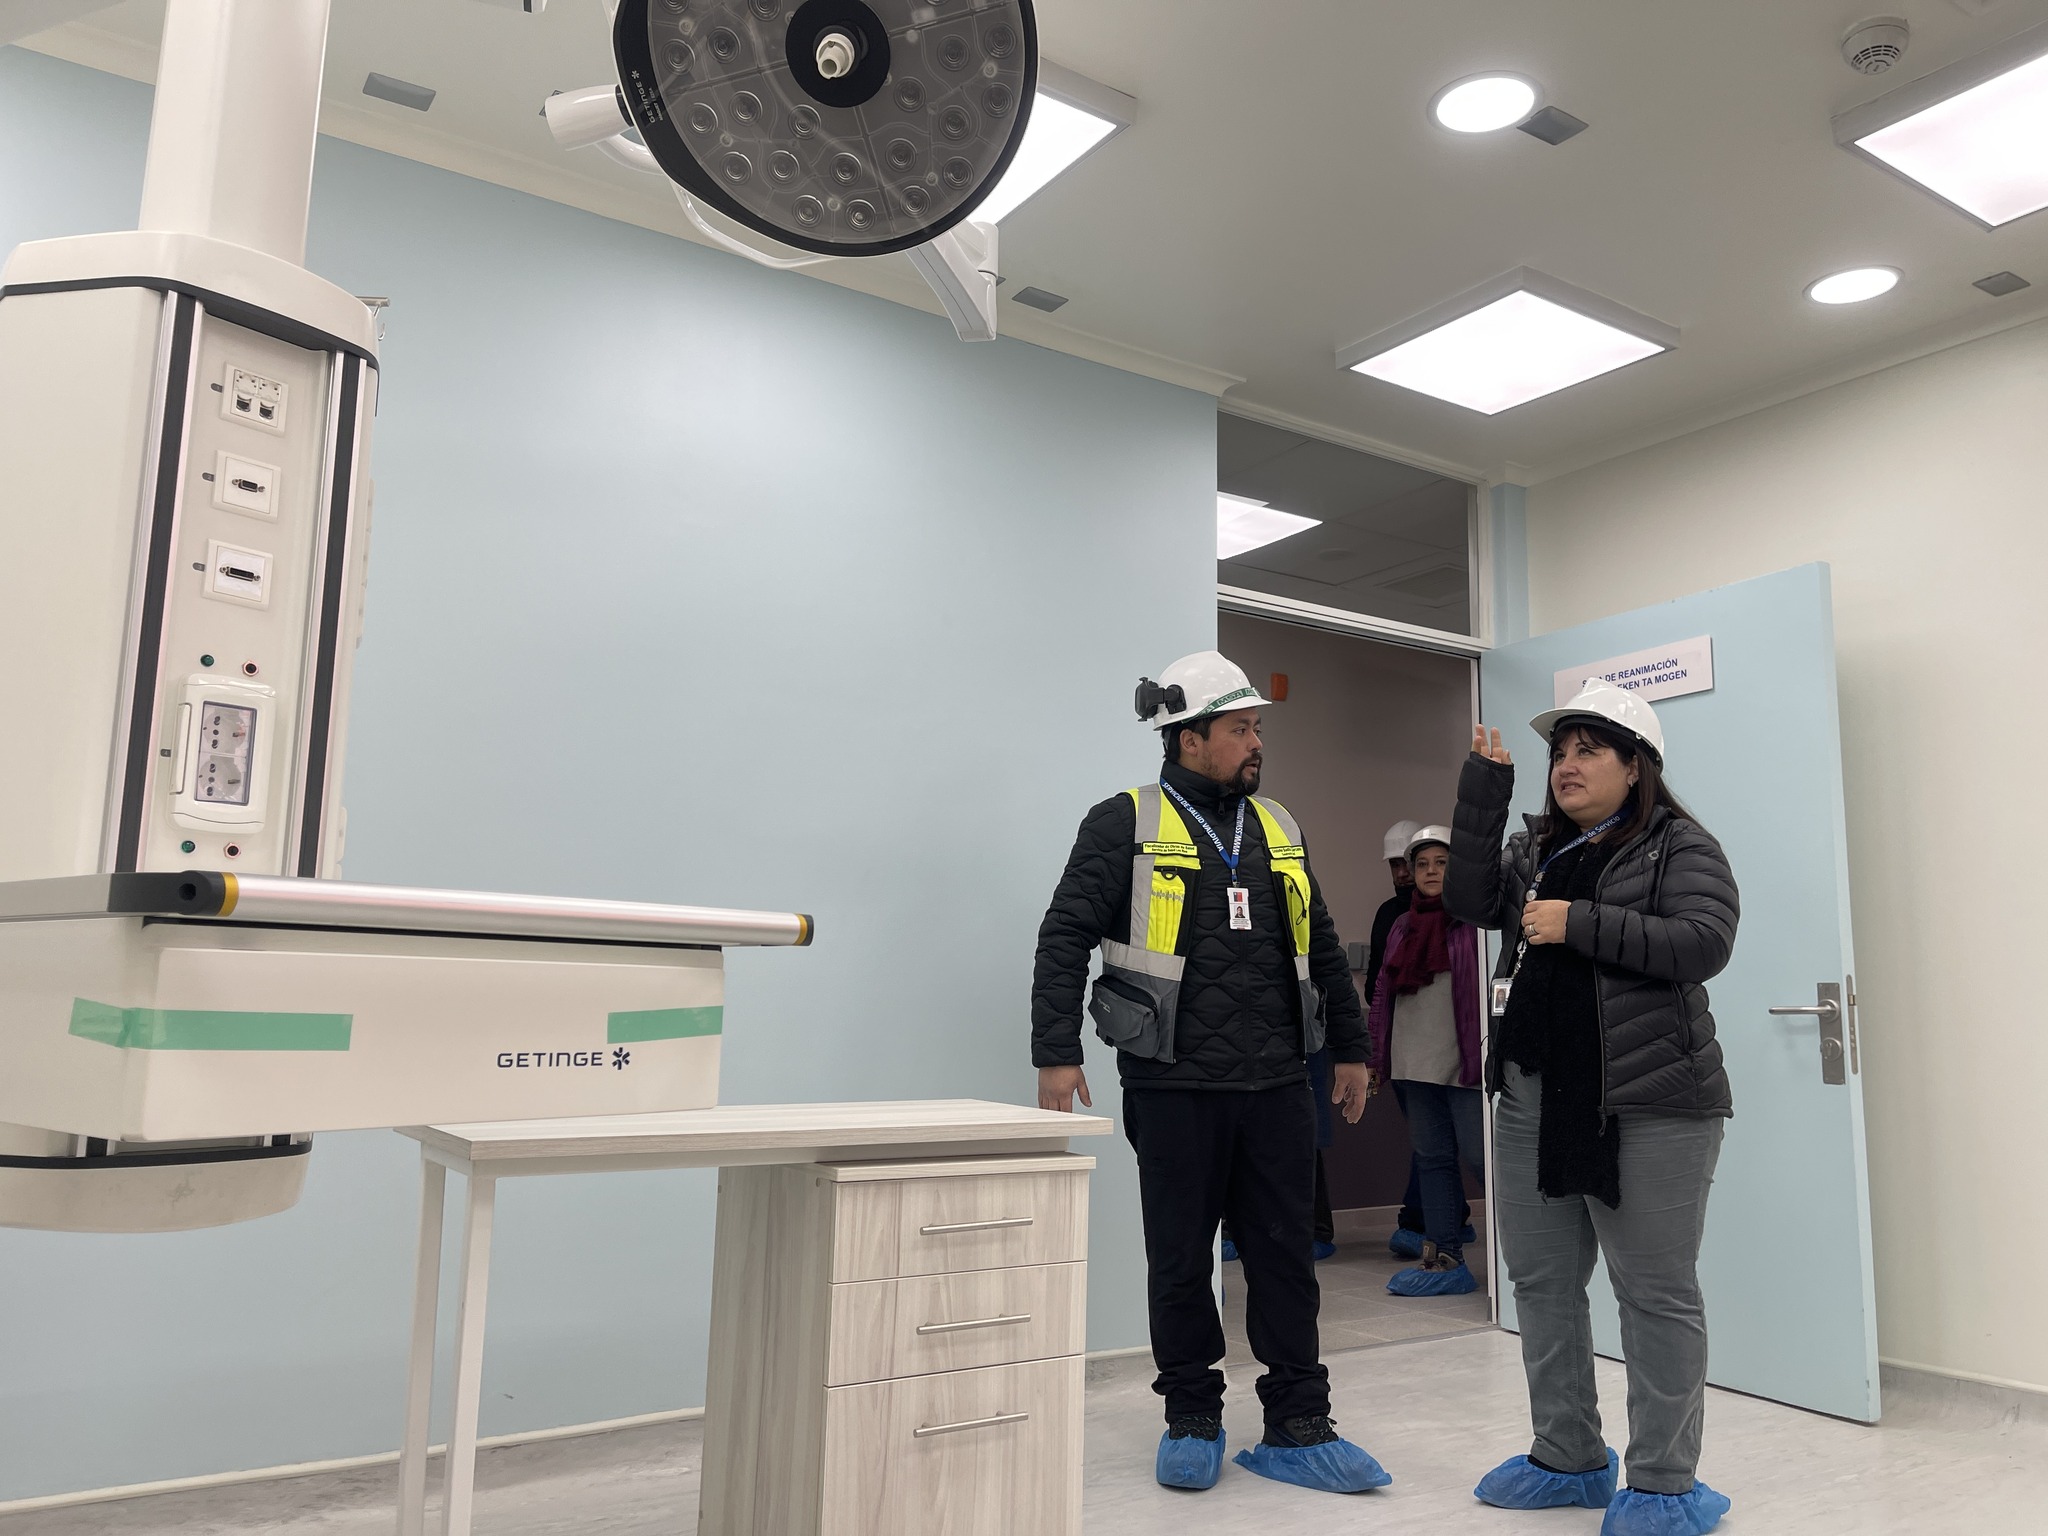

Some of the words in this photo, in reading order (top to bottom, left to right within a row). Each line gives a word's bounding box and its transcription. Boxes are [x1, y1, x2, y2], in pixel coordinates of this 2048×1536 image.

[636, 81, 655, 123] GETINGE
[1605, 672, 1616, 682] DE
[1618, 657, 1678, 680] REANIMACIÓN
[1642, 676, 1653, 687] TA
[1654, 669, 1687, 684] MOGEN
[1218, 691, 1243, 705] MSA
[1162, 781, 1184, 803] SERVICIO
[1187, 806, 1206, 824] SALUD
[1204, 822, 1223, 852] VALDIVIA
[1587, 830, 1597, 838] de
[1594, 815, 1621, 833] Servicio
[497, 1052, 603, 1068] GETINGE
